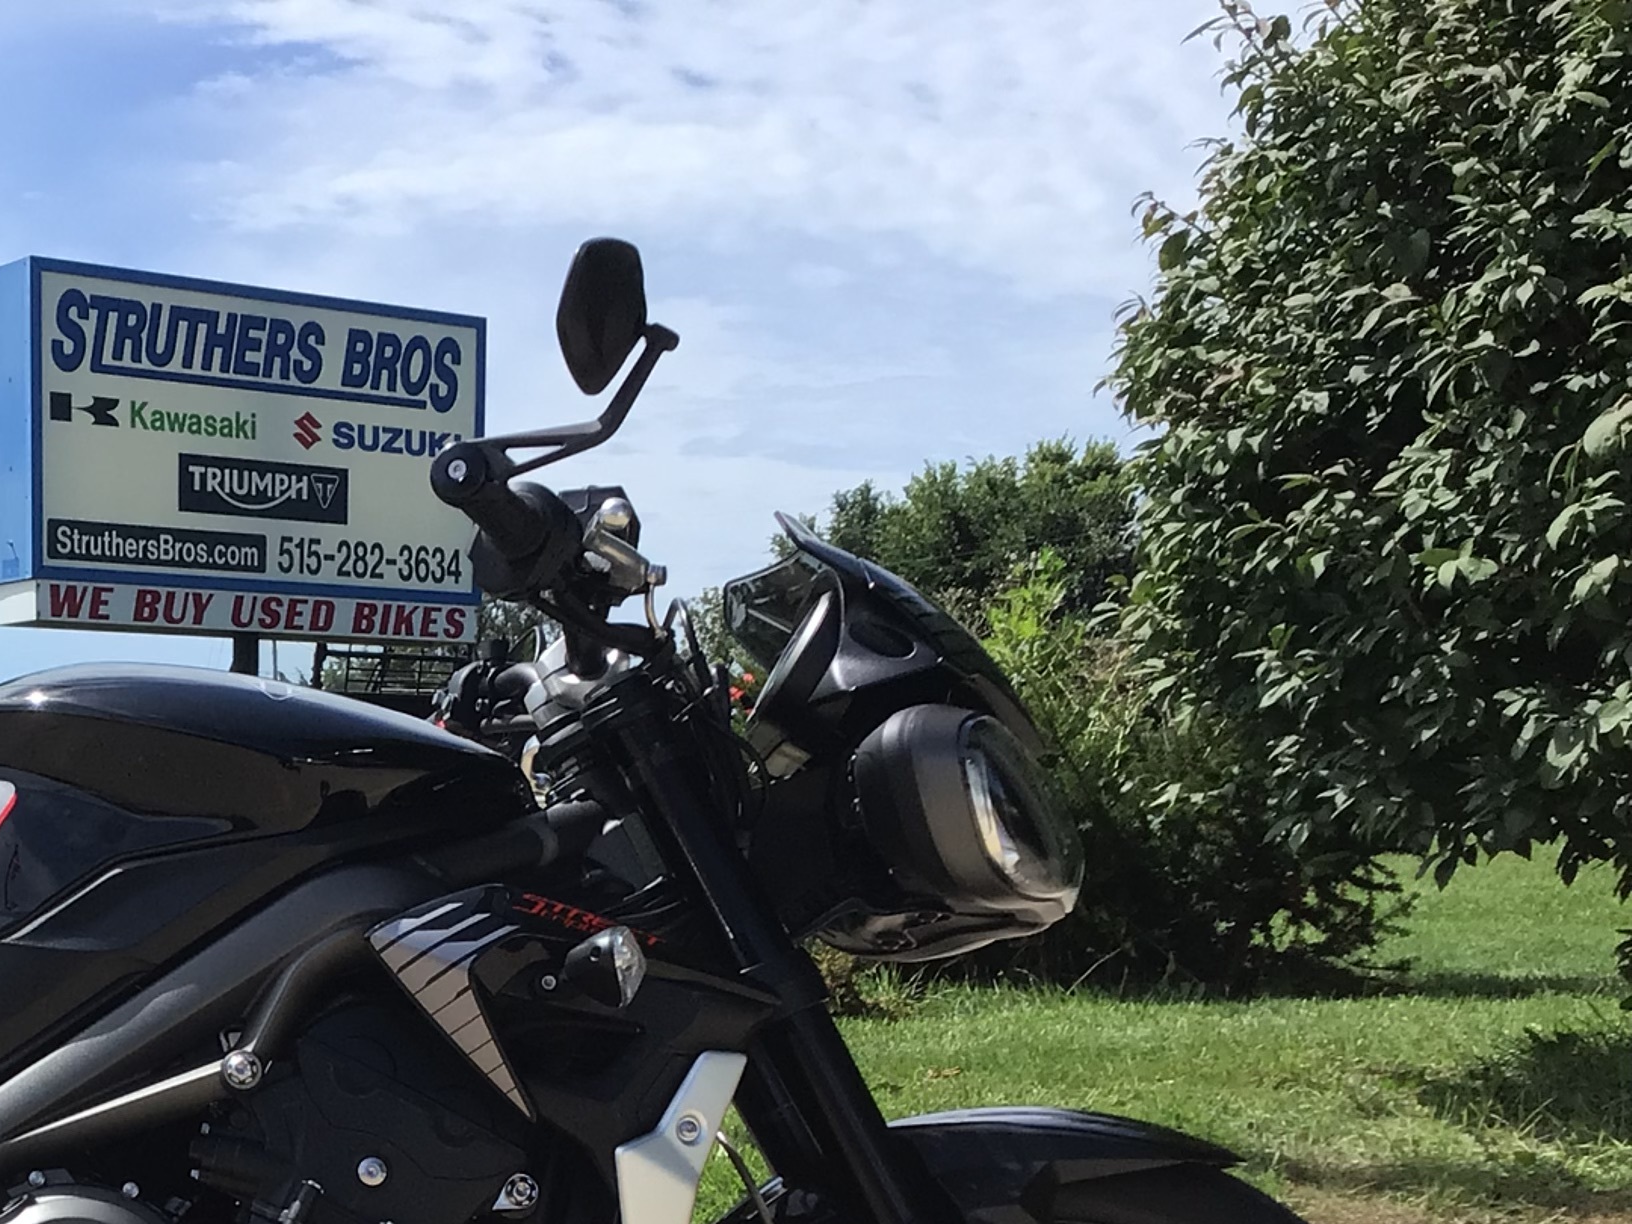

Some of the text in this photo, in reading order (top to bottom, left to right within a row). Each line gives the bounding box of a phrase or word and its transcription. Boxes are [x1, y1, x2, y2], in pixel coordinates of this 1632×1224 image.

[51, 288, 462, 412] STRUTHERS BROS
[130, 400, 257, 440] Kawasaki
[188, 464, 309, 508] TRIUMPH
[56, 525, 259, 568] StruthersBros.com
[277, 536, 462, 584] 515-282-3634
[49, 584, 466, 640] WE BUY USED BIKES
